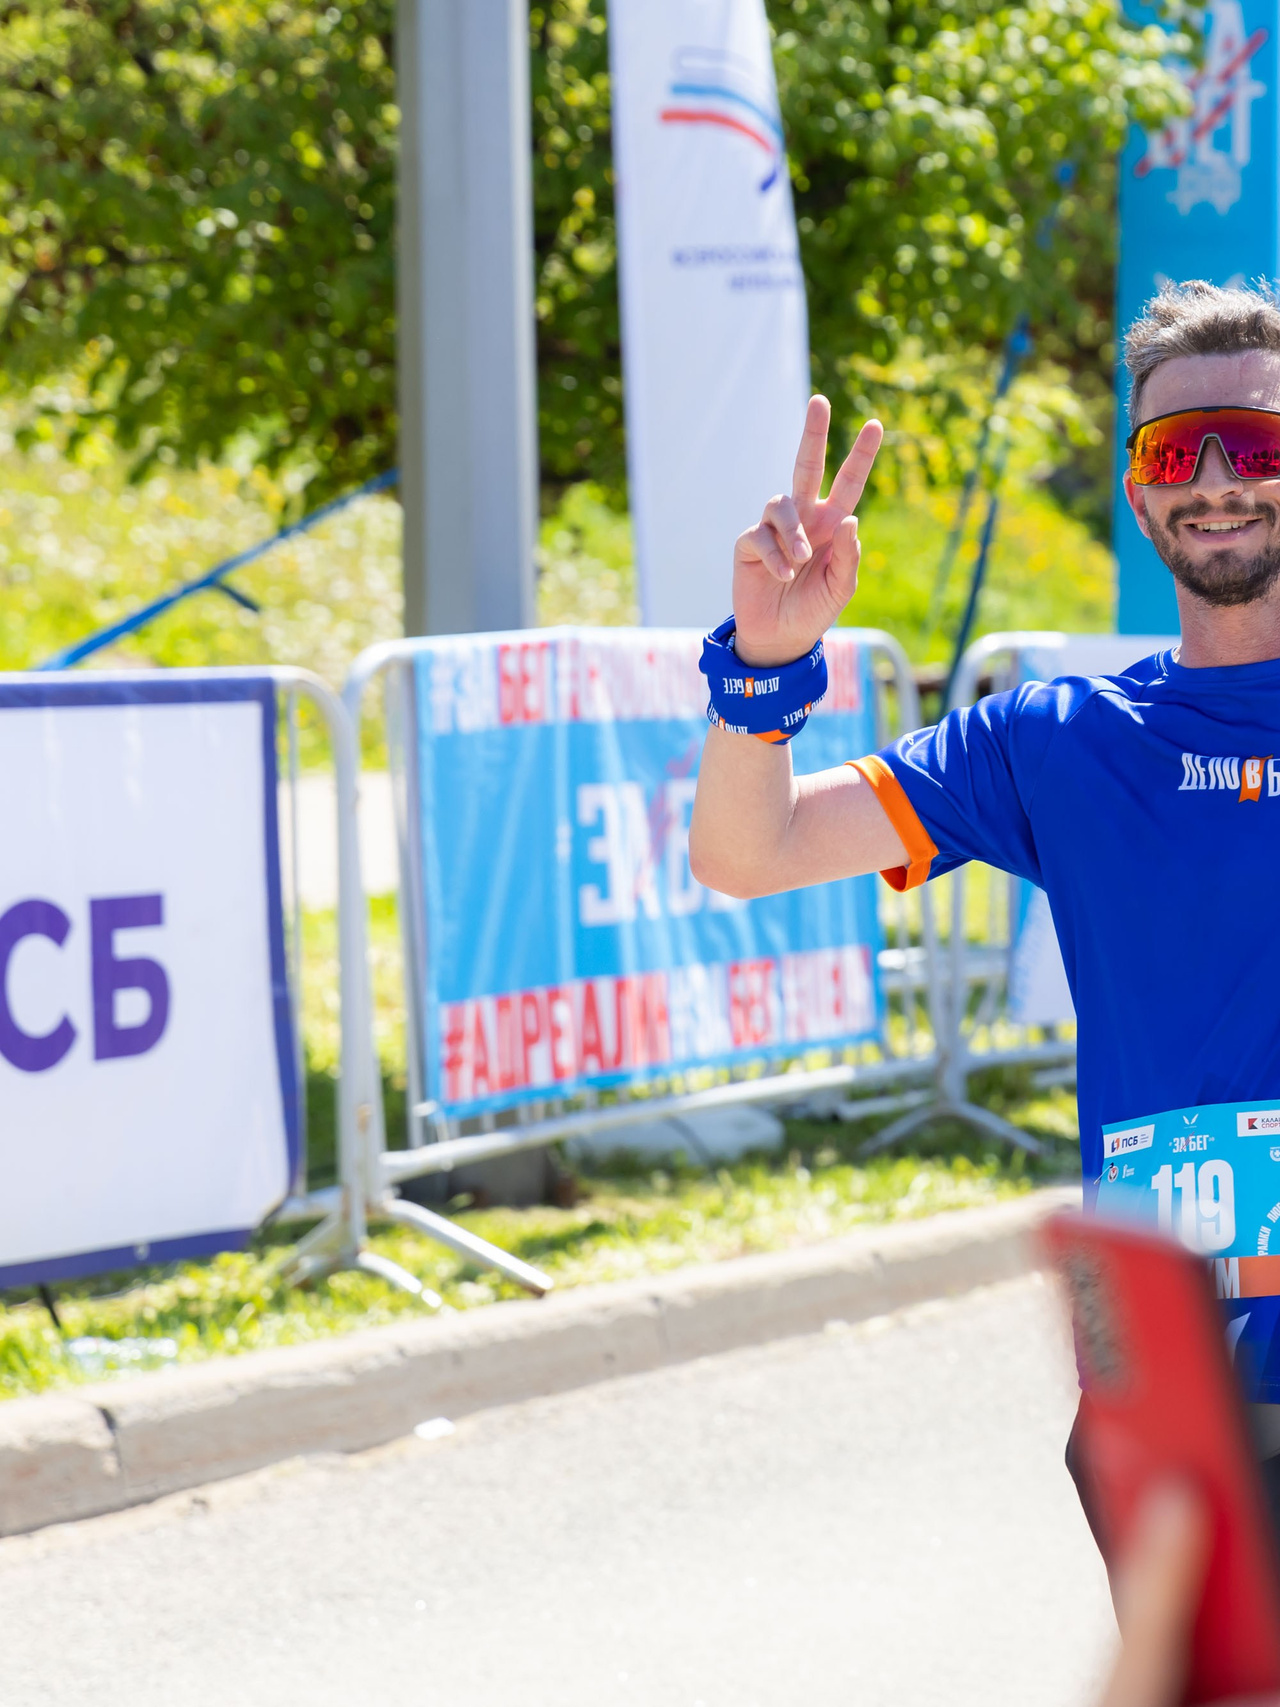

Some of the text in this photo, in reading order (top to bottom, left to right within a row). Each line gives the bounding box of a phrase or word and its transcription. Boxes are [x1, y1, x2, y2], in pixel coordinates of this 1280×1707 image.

[1178, 752, 1241, 790] ДЕЛО
[1245, 759, 1261, 789] В
[1121, 1135, 1139, 1149] ПСБ
[1151, 1159, 1237, 1251] 119
[1257, 1225, 1271, 1256] РАМКИ
